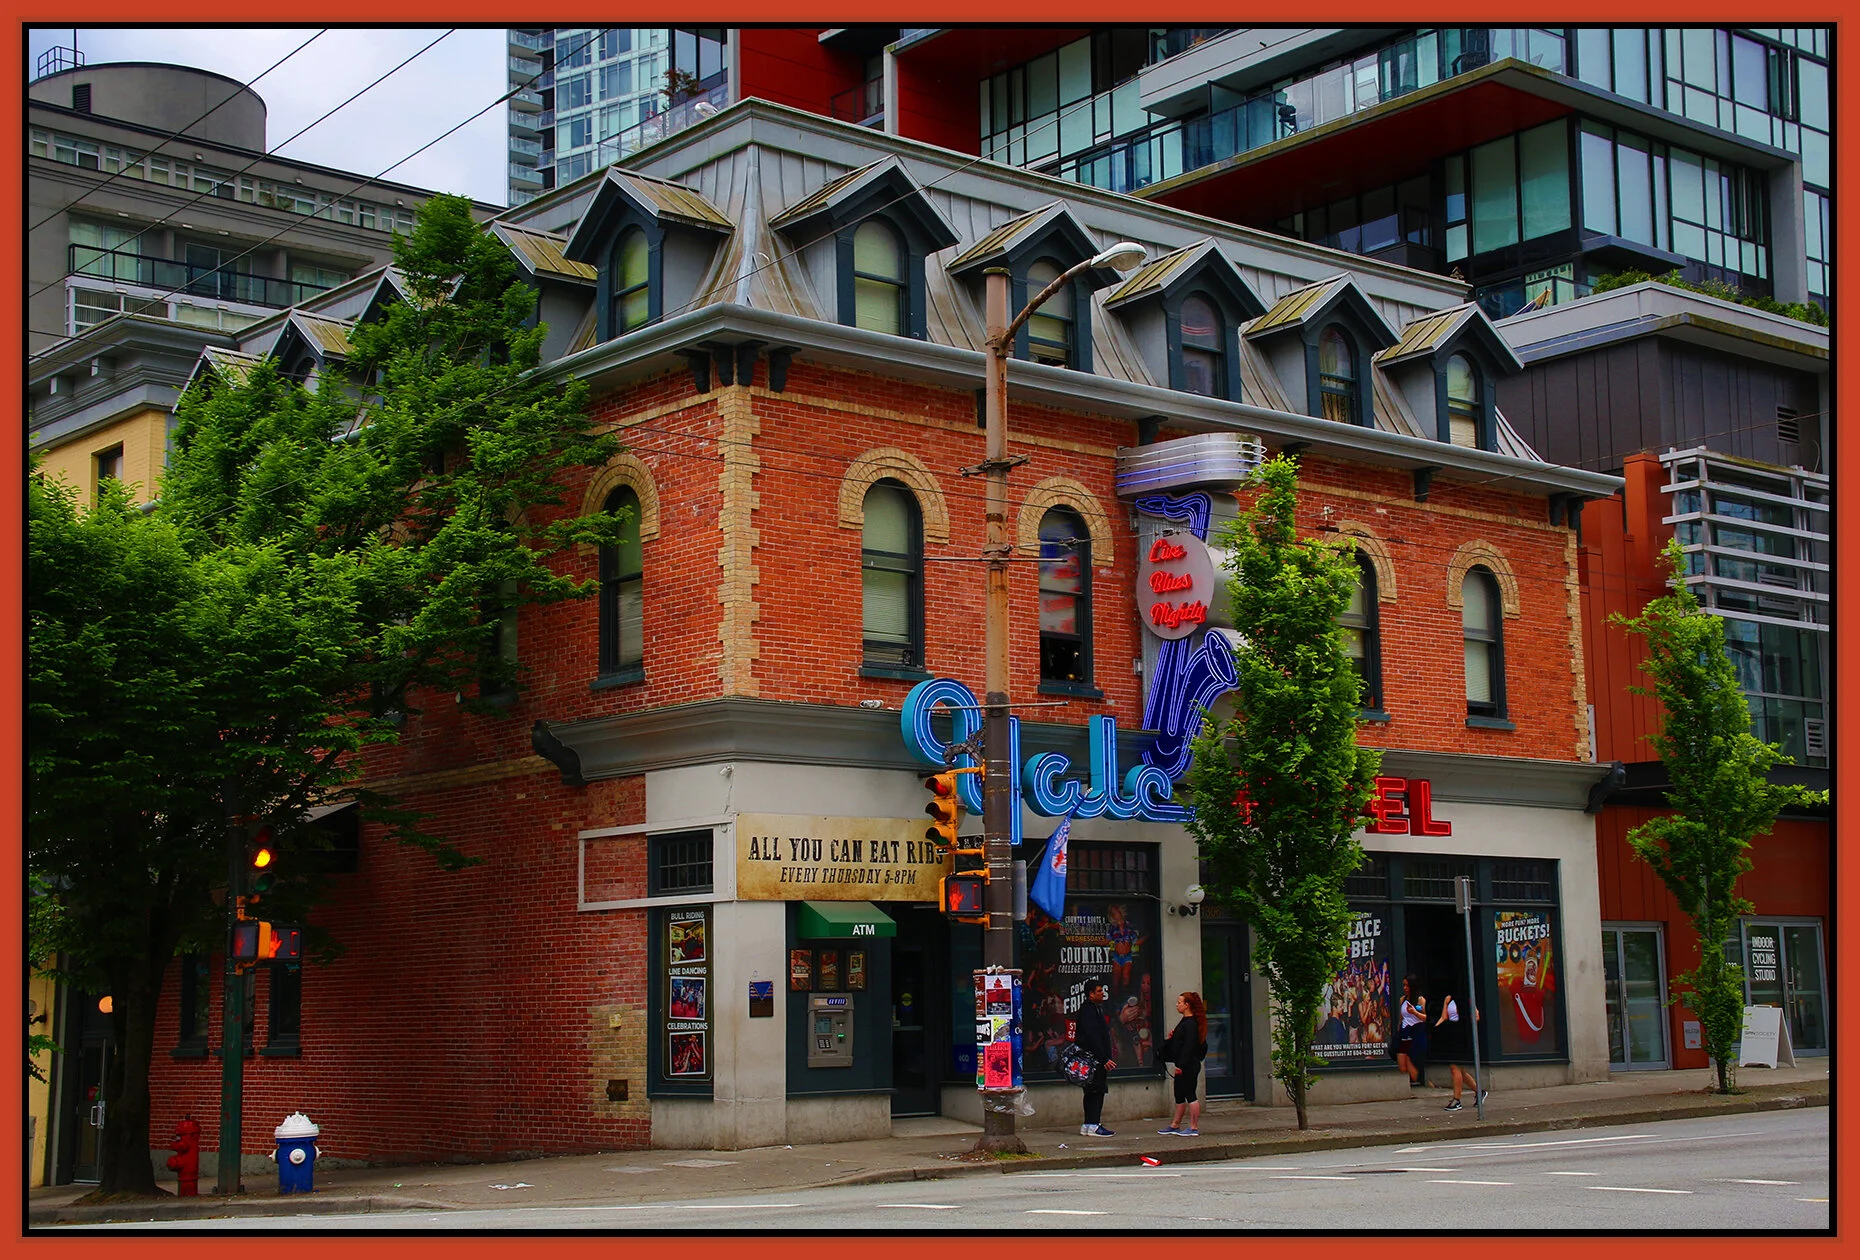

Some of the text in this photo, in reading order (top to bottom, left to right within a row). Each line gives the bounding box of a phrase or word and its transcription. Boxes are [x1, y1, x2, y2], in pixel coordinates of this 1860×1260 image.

[1149, 539, 1187, 562] Live
[1149, 571, 1192, 594] Blues
[1150, 600, 1207, 628] Nightly
[747, 837, 781, 861] ALL
[789, 837, 823, 862] YOU
[830, 839, 863, 862] CAN
[870, 840, 899, 864] EAT
[780, 867, 916, 885] EVERY THURSDAY 5-8PM
[671, 911, 705, 920] BULL RIDING
[852, 925, 875, 935] ATM
[1347, 919, 1381, 939] LACE
[1497, 923, 1550, 944] BUCKETS!
[1351, 939, 1375, 958] BE!
[1752, 936, 1774, 948] INDOOR
[1060, 946, 1111, 963] COUNTRY
[1752, 953, 1776, 965] CYCLING
[669, 967, 707, 975] LINE DANCING
[1058, 964, 1081, 973] COLLEGE
[1754, 969, 1776, 981] STUDIO
[1063, 984, 1110, 1015] FRIDS
[667, 1022, 708, 1030] CELEBRATIONS
